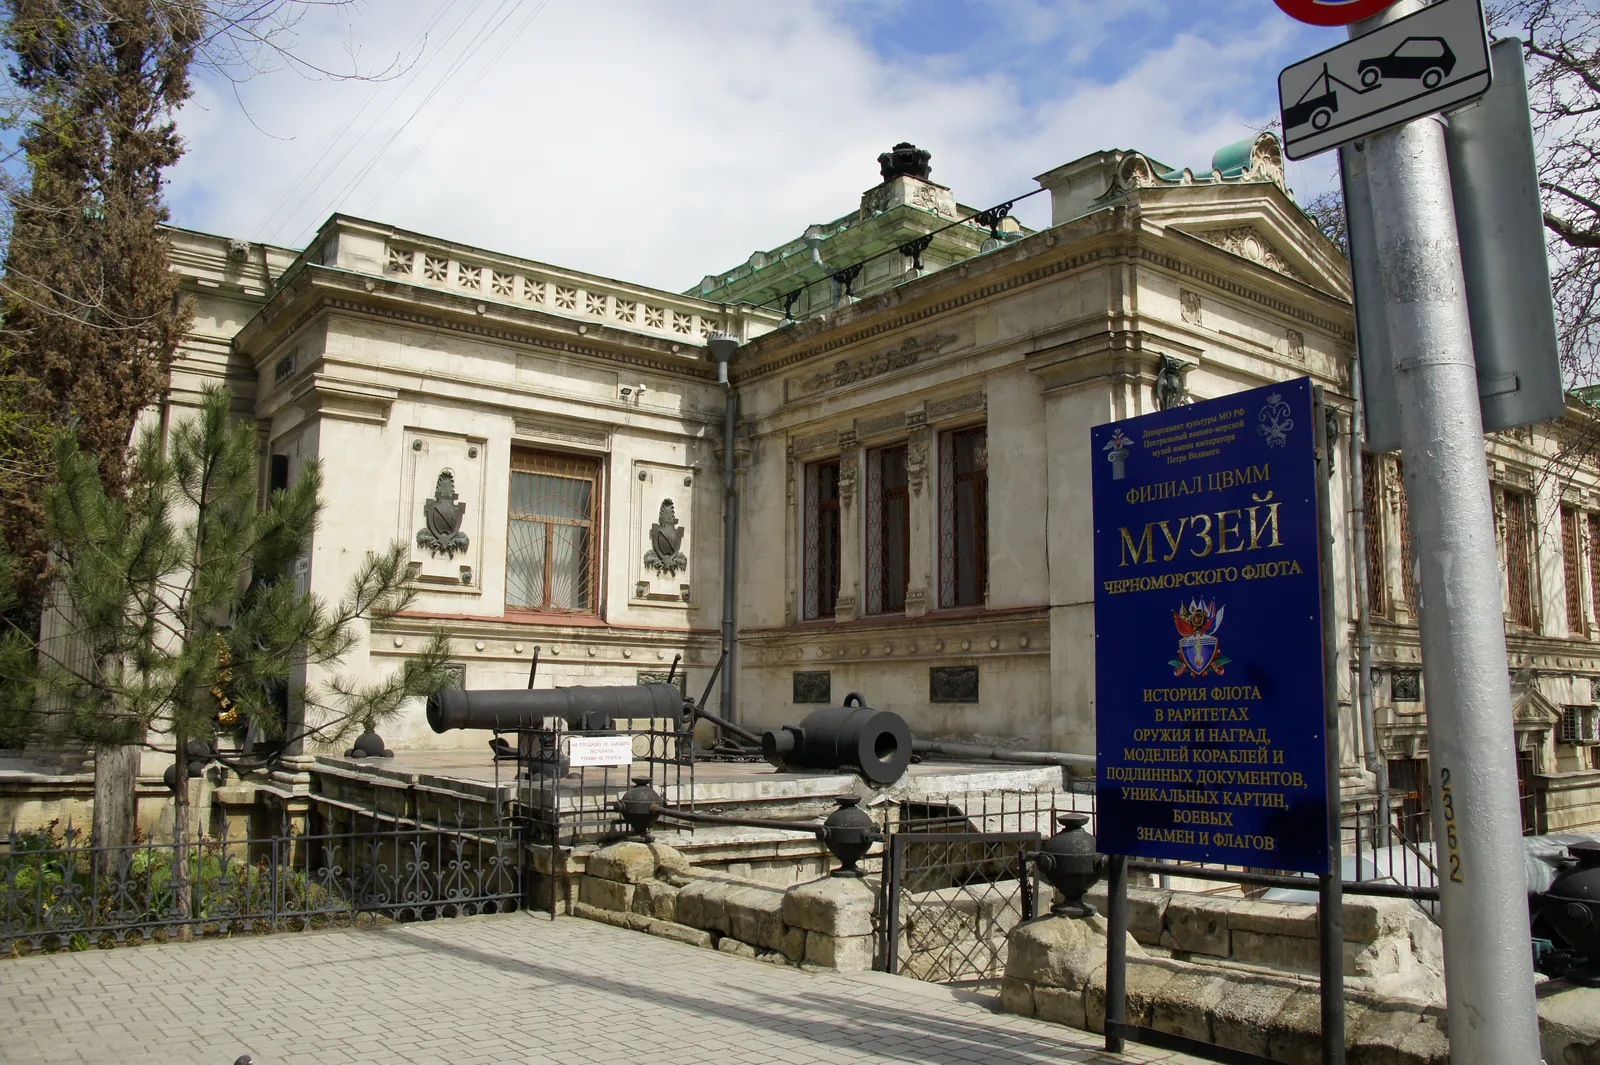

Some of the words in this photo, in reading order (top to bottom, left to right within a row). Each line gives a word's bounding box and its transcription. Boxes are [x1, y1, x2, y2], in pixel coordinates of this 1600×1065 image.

[1142, 423, 1184, 439] Департамент
[1186, 416, 1217, 428] культуры
[1218, 411, 1232, 420] МО
[1234, 408, 1245, 417] РФ
[1144, 433, 1188, 448] Центральный
[1189, 420, 1244, 438] военно-морской
[1152, 446, 1171, 458] музей
[1173, 443, 1194, 452] имени
[1196, 434, 1235, 447] императора
[1167, 455, 1187, 464] Петра
[1189, 449, 1220, 459] Великого
[1126, 476, 1203, 504] ФИЛИАЛ
[1208, 463, 1271, 492] ЦВММ
[1117, 490, 1284, 567] МУЗЕЙ
[1104, 567, 1238, 595] ЧЕРНОМОРСКОГО
[1242, 559, 1303, 580] ФЛОТА
[1143, 688, 1207, 702] ИСТОРИЯ
[1211, 686, 1262, 701] ФЛОТА
[1155, 709, 1164, 721] В
[1167, 707, 1249, 721] РАРИТЕТАХ
[1133, 729, 1191, 742] ОРУЖИЯ
[1195, 729, 1205, 742] И
[1209, 729, 1271, 744] НАГРАД,
[1124, 746, 1188, 764] МОДЕЛЕЙ
[1193, 747, 1268, 764] КОРАБЛЕЙ
[1272, 750, 1284, 764] И
[1106, 767, 1193, 783] ПОДЛИННЫХ
[1196, 770, 1308, 789] ДОКУМЕНТОВ,
[1122, 787, 1219, 805] УНИКАЛЬНЫХ
[1223, 792, 1289, 810] КАРТИН,
[1173, 809, 1233, 826] БОЕВЫХ
[1137, 827, 1195, 844] ЗНАМЕН
[1198, 831, 1209, 845] И
[1213, 832, 1275, 850] ФЛАГОВ
